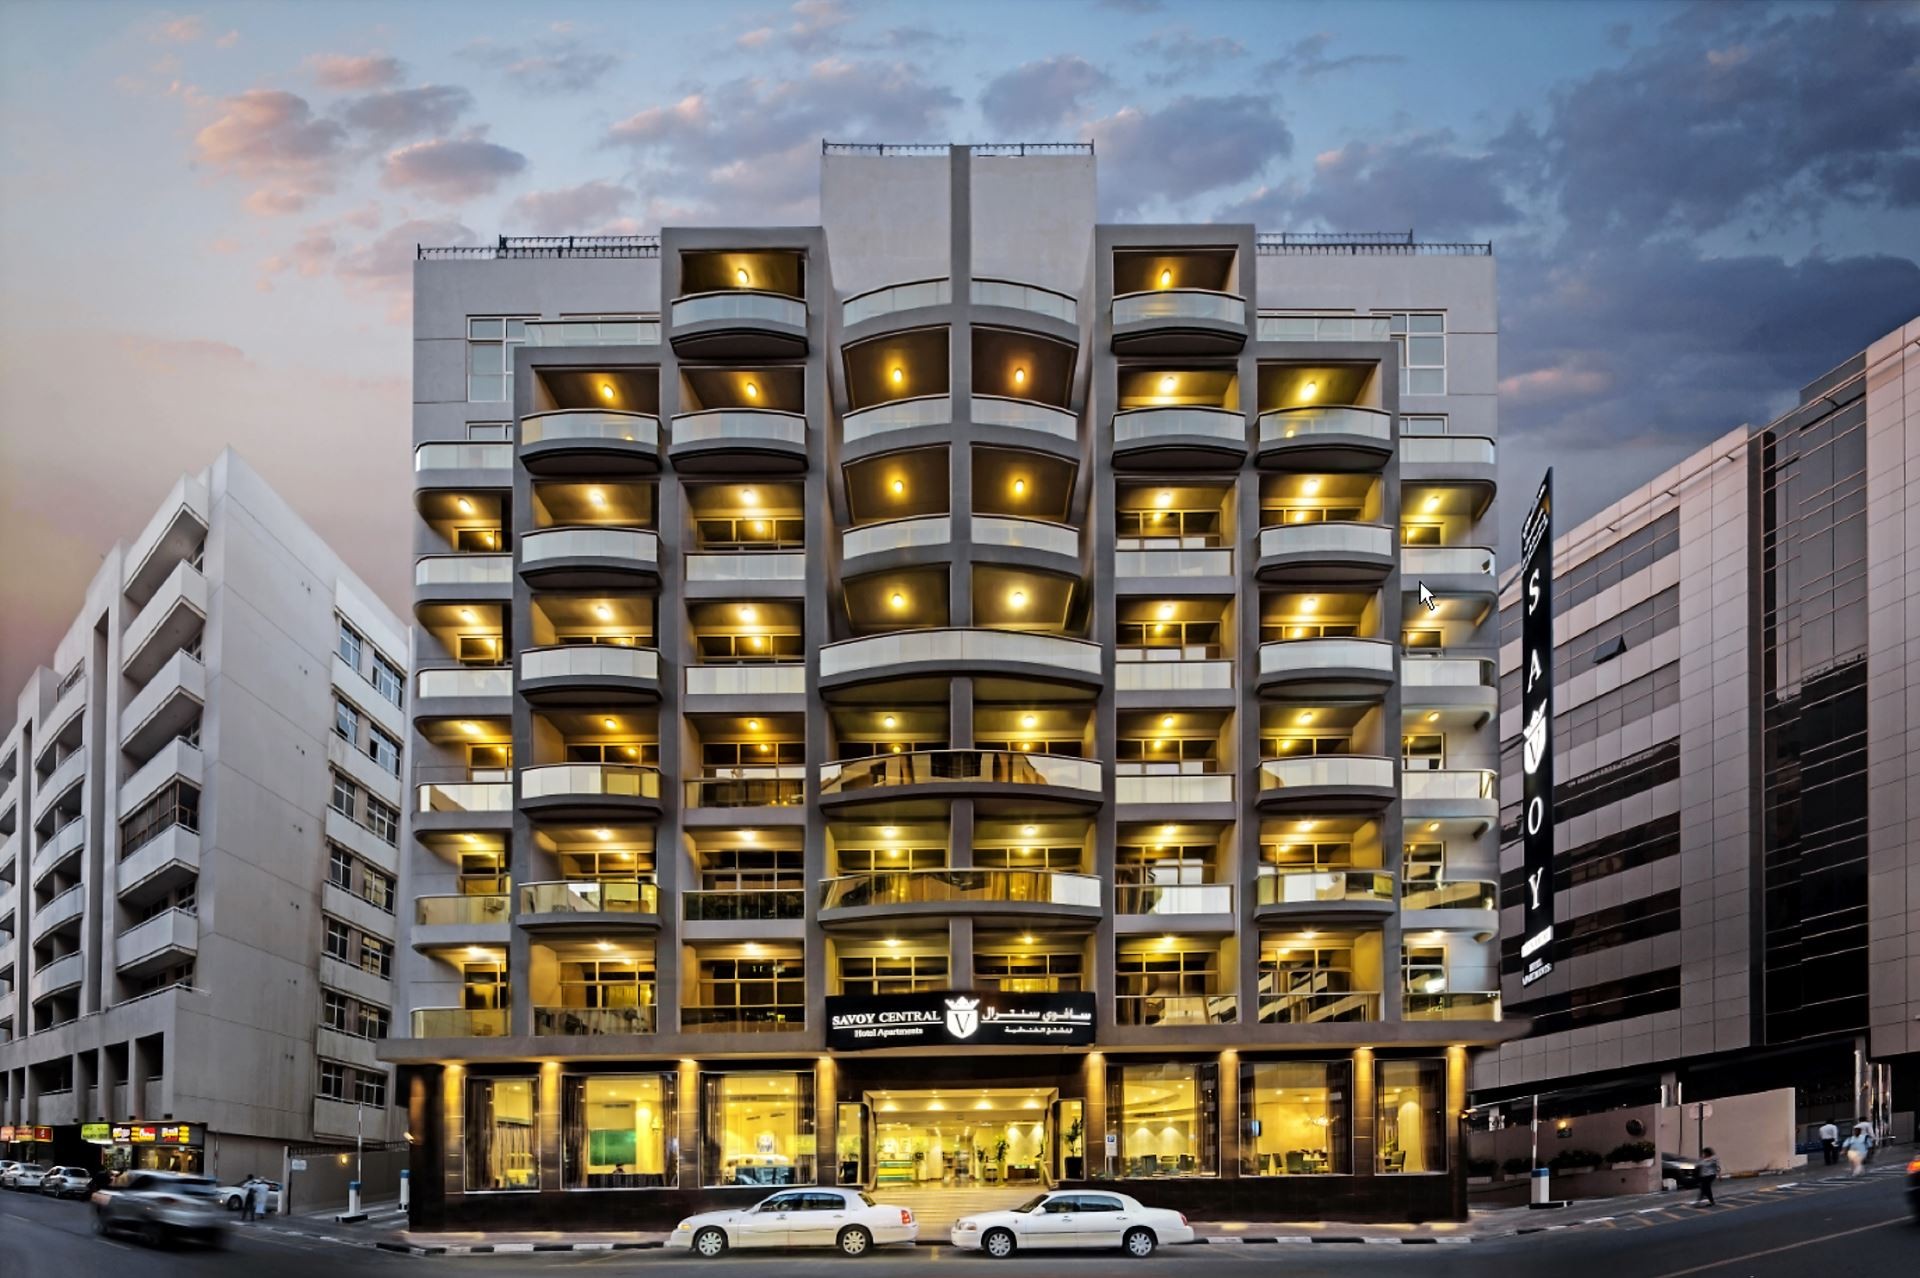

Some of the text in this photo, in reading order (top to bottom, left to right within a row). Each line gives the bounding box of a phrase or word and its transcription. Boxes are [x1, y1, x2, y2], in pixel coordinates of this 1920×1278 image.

[832, 1010, 941, 1026] SAVOY CENTRAL
[981, 1006, 1040, 1021] سنترال
[854, 1028, 923, 1038] Hotel Apartments
